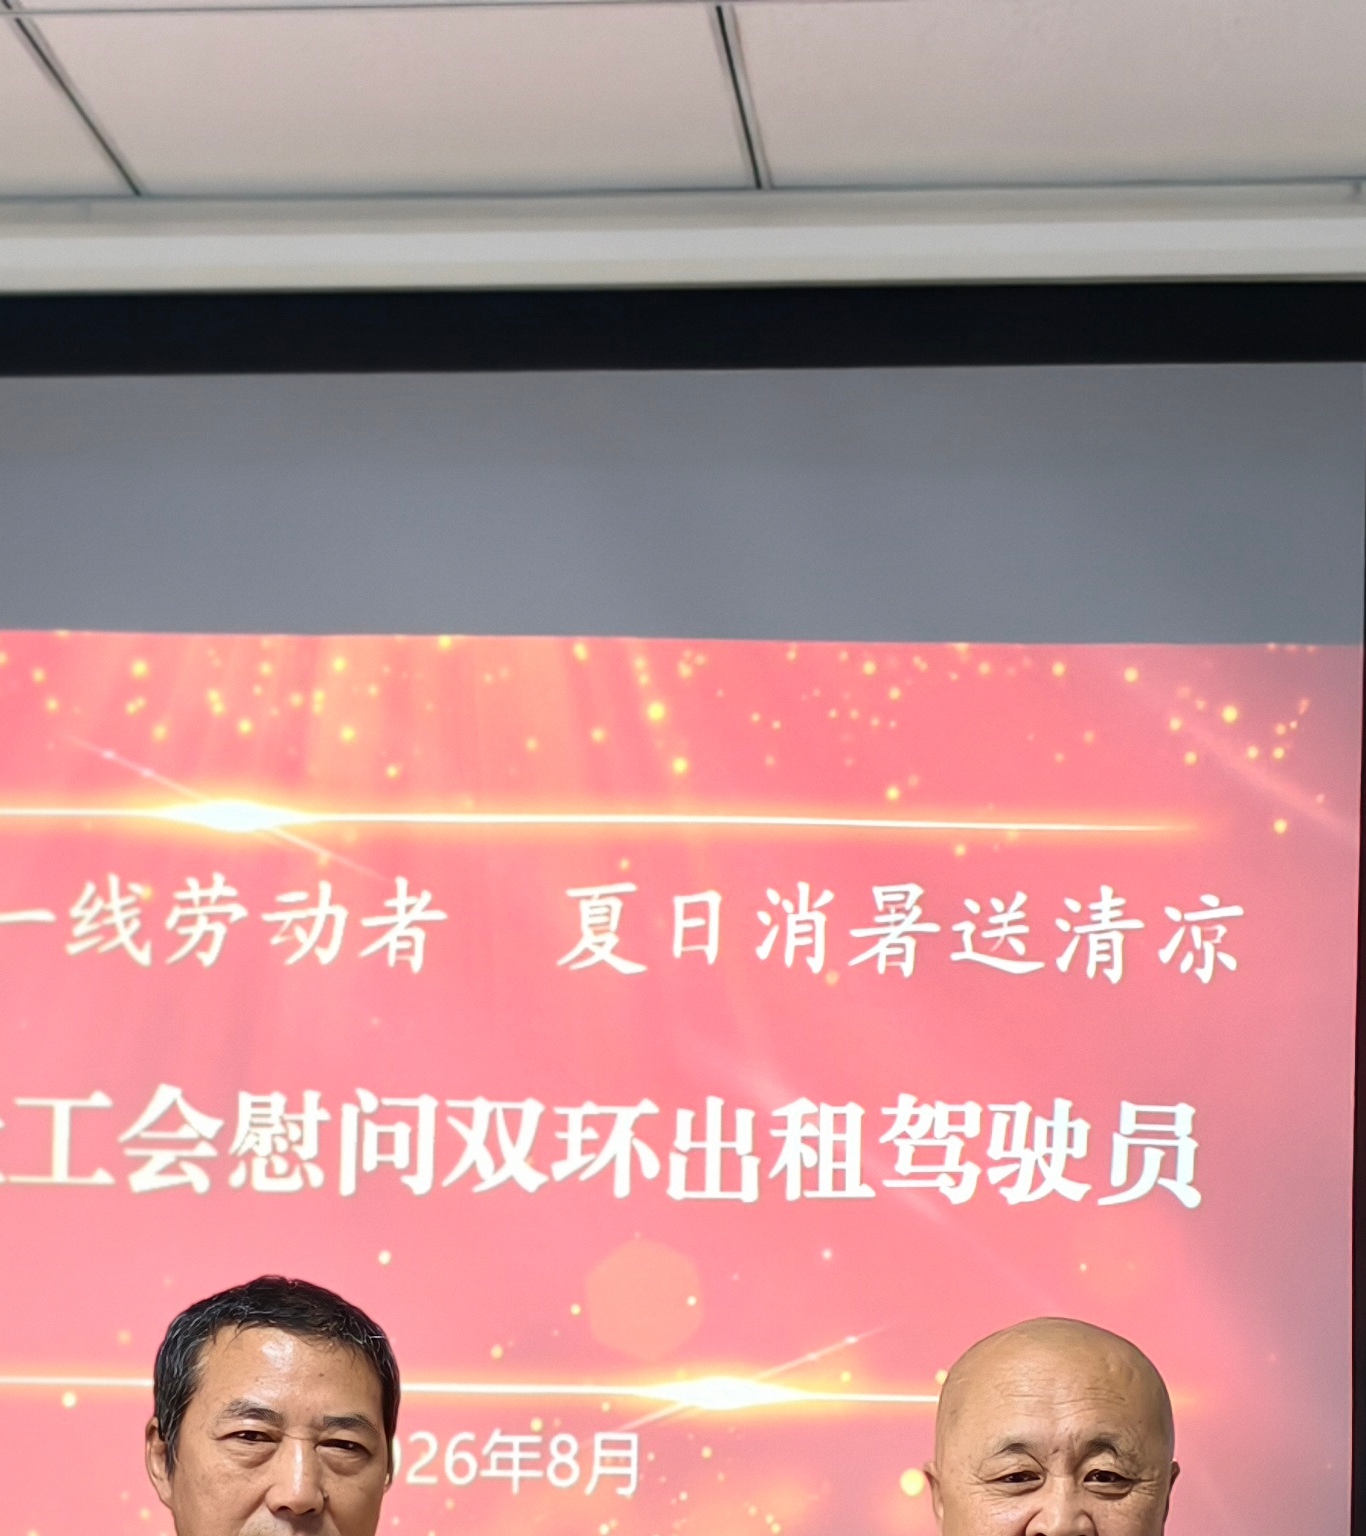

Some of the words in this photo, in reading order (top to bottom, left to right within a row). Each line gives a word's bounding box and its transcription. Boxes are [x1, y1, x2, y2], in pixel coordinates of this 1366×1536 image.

[557, 881, 1245, 985] 夏日消暑送清凉
[392, 1429, 639, 1496] 26年8月
